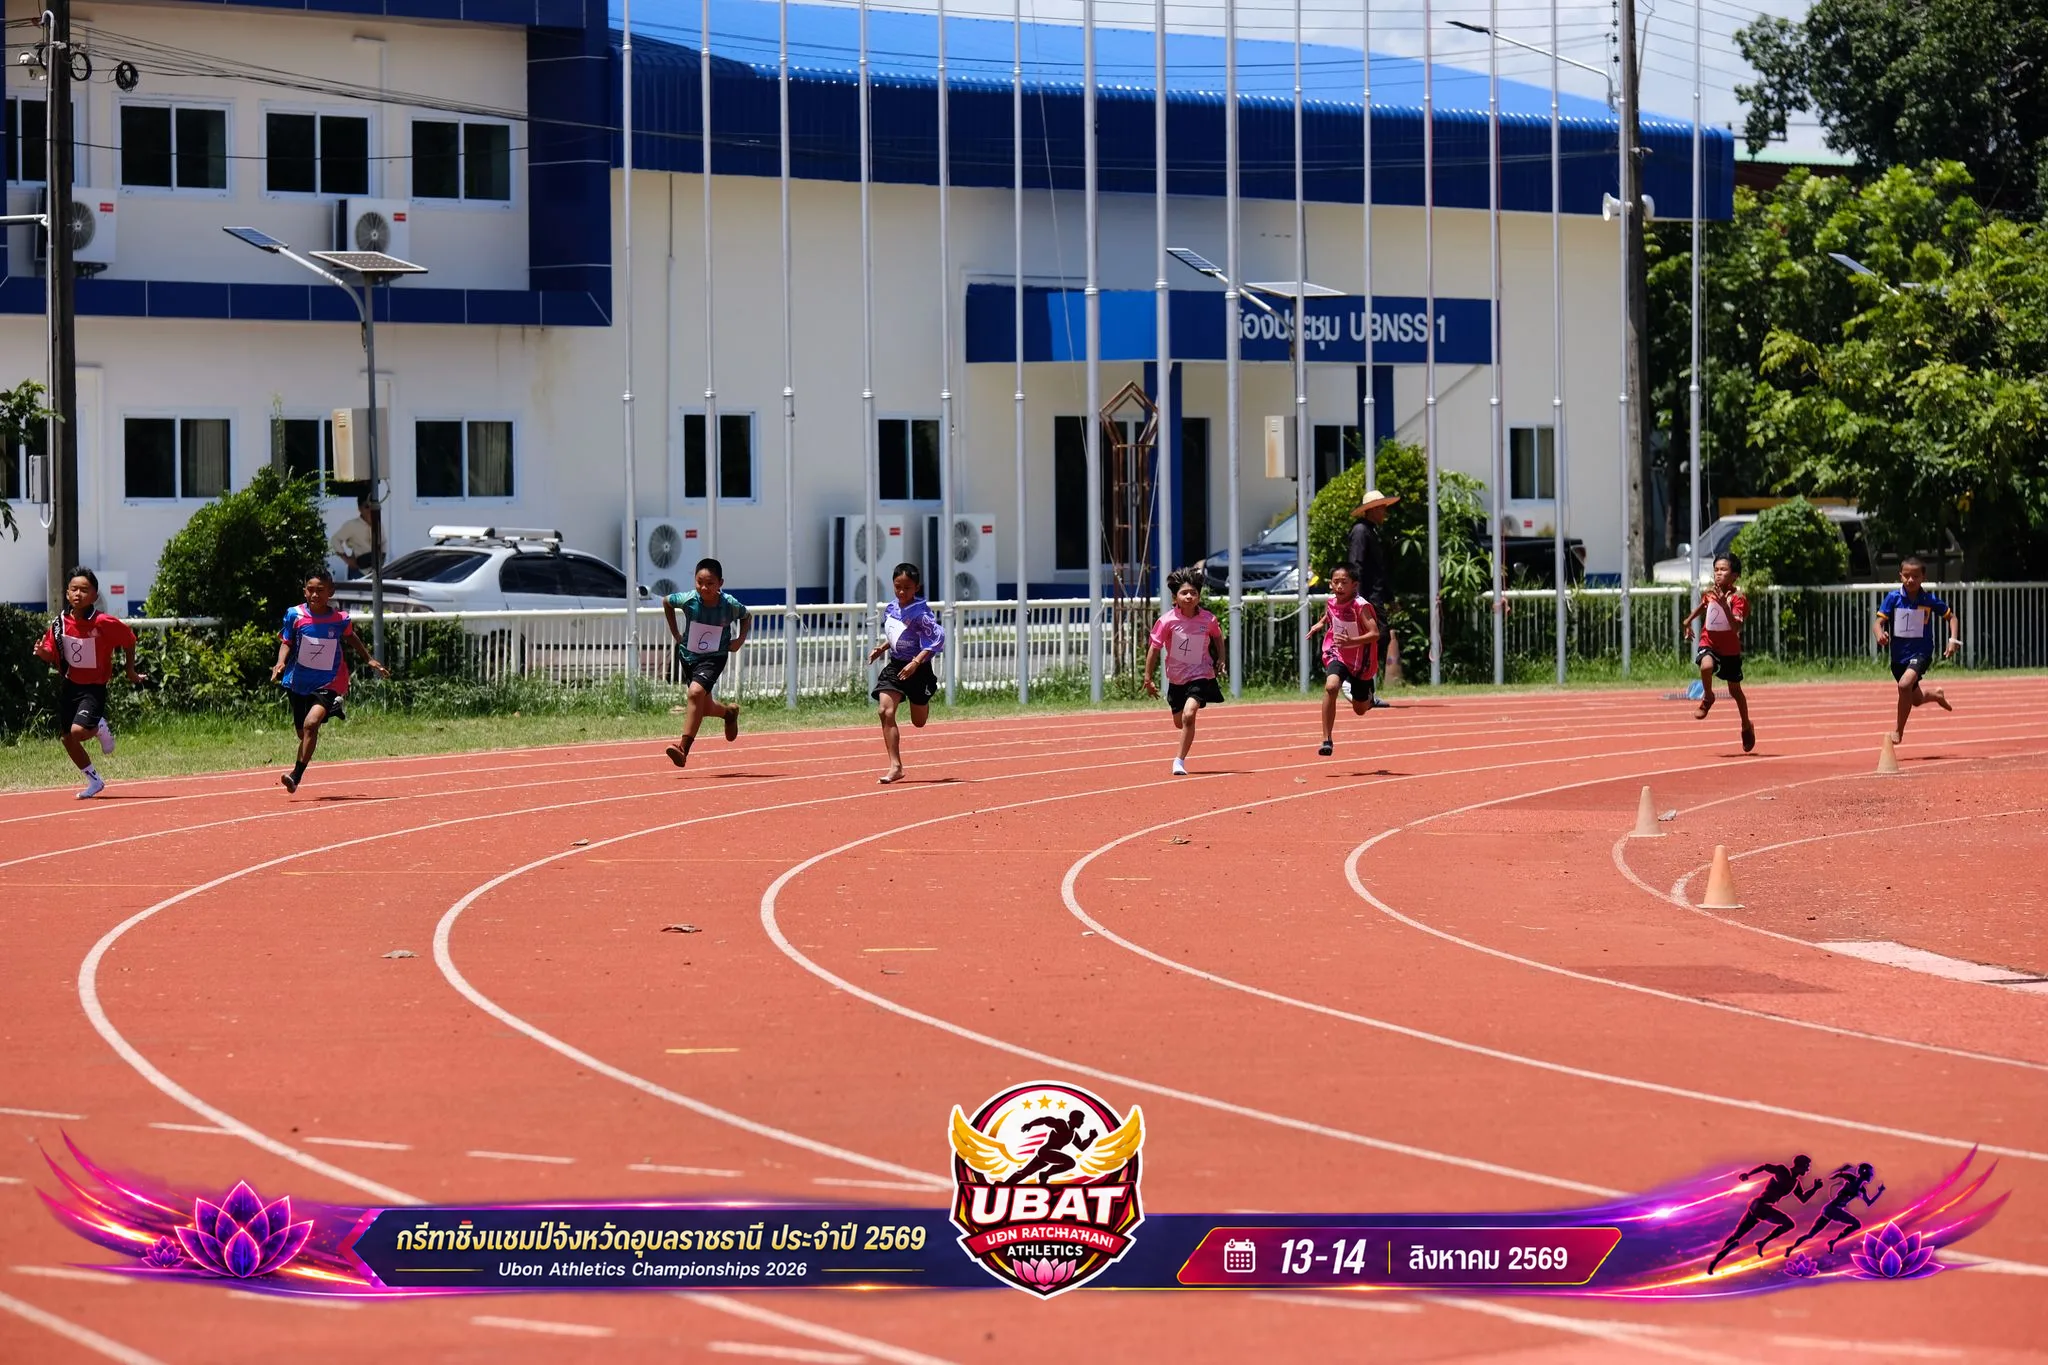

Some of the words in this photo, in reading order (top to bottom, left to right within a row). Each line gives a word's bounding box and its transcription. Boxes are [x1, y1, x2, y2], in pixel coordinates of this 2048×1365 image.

[1351, 312, 1429, 343] UBNSS
[1710, 607, 1723, 625] 2
[1900, 612, 1915, 632] 1
[698, 631, 713, 651] 6
[1178, 638, 1192, 656] 4
[71, 642, 82, 663] 8
[310, 643, 326, 661] 7
